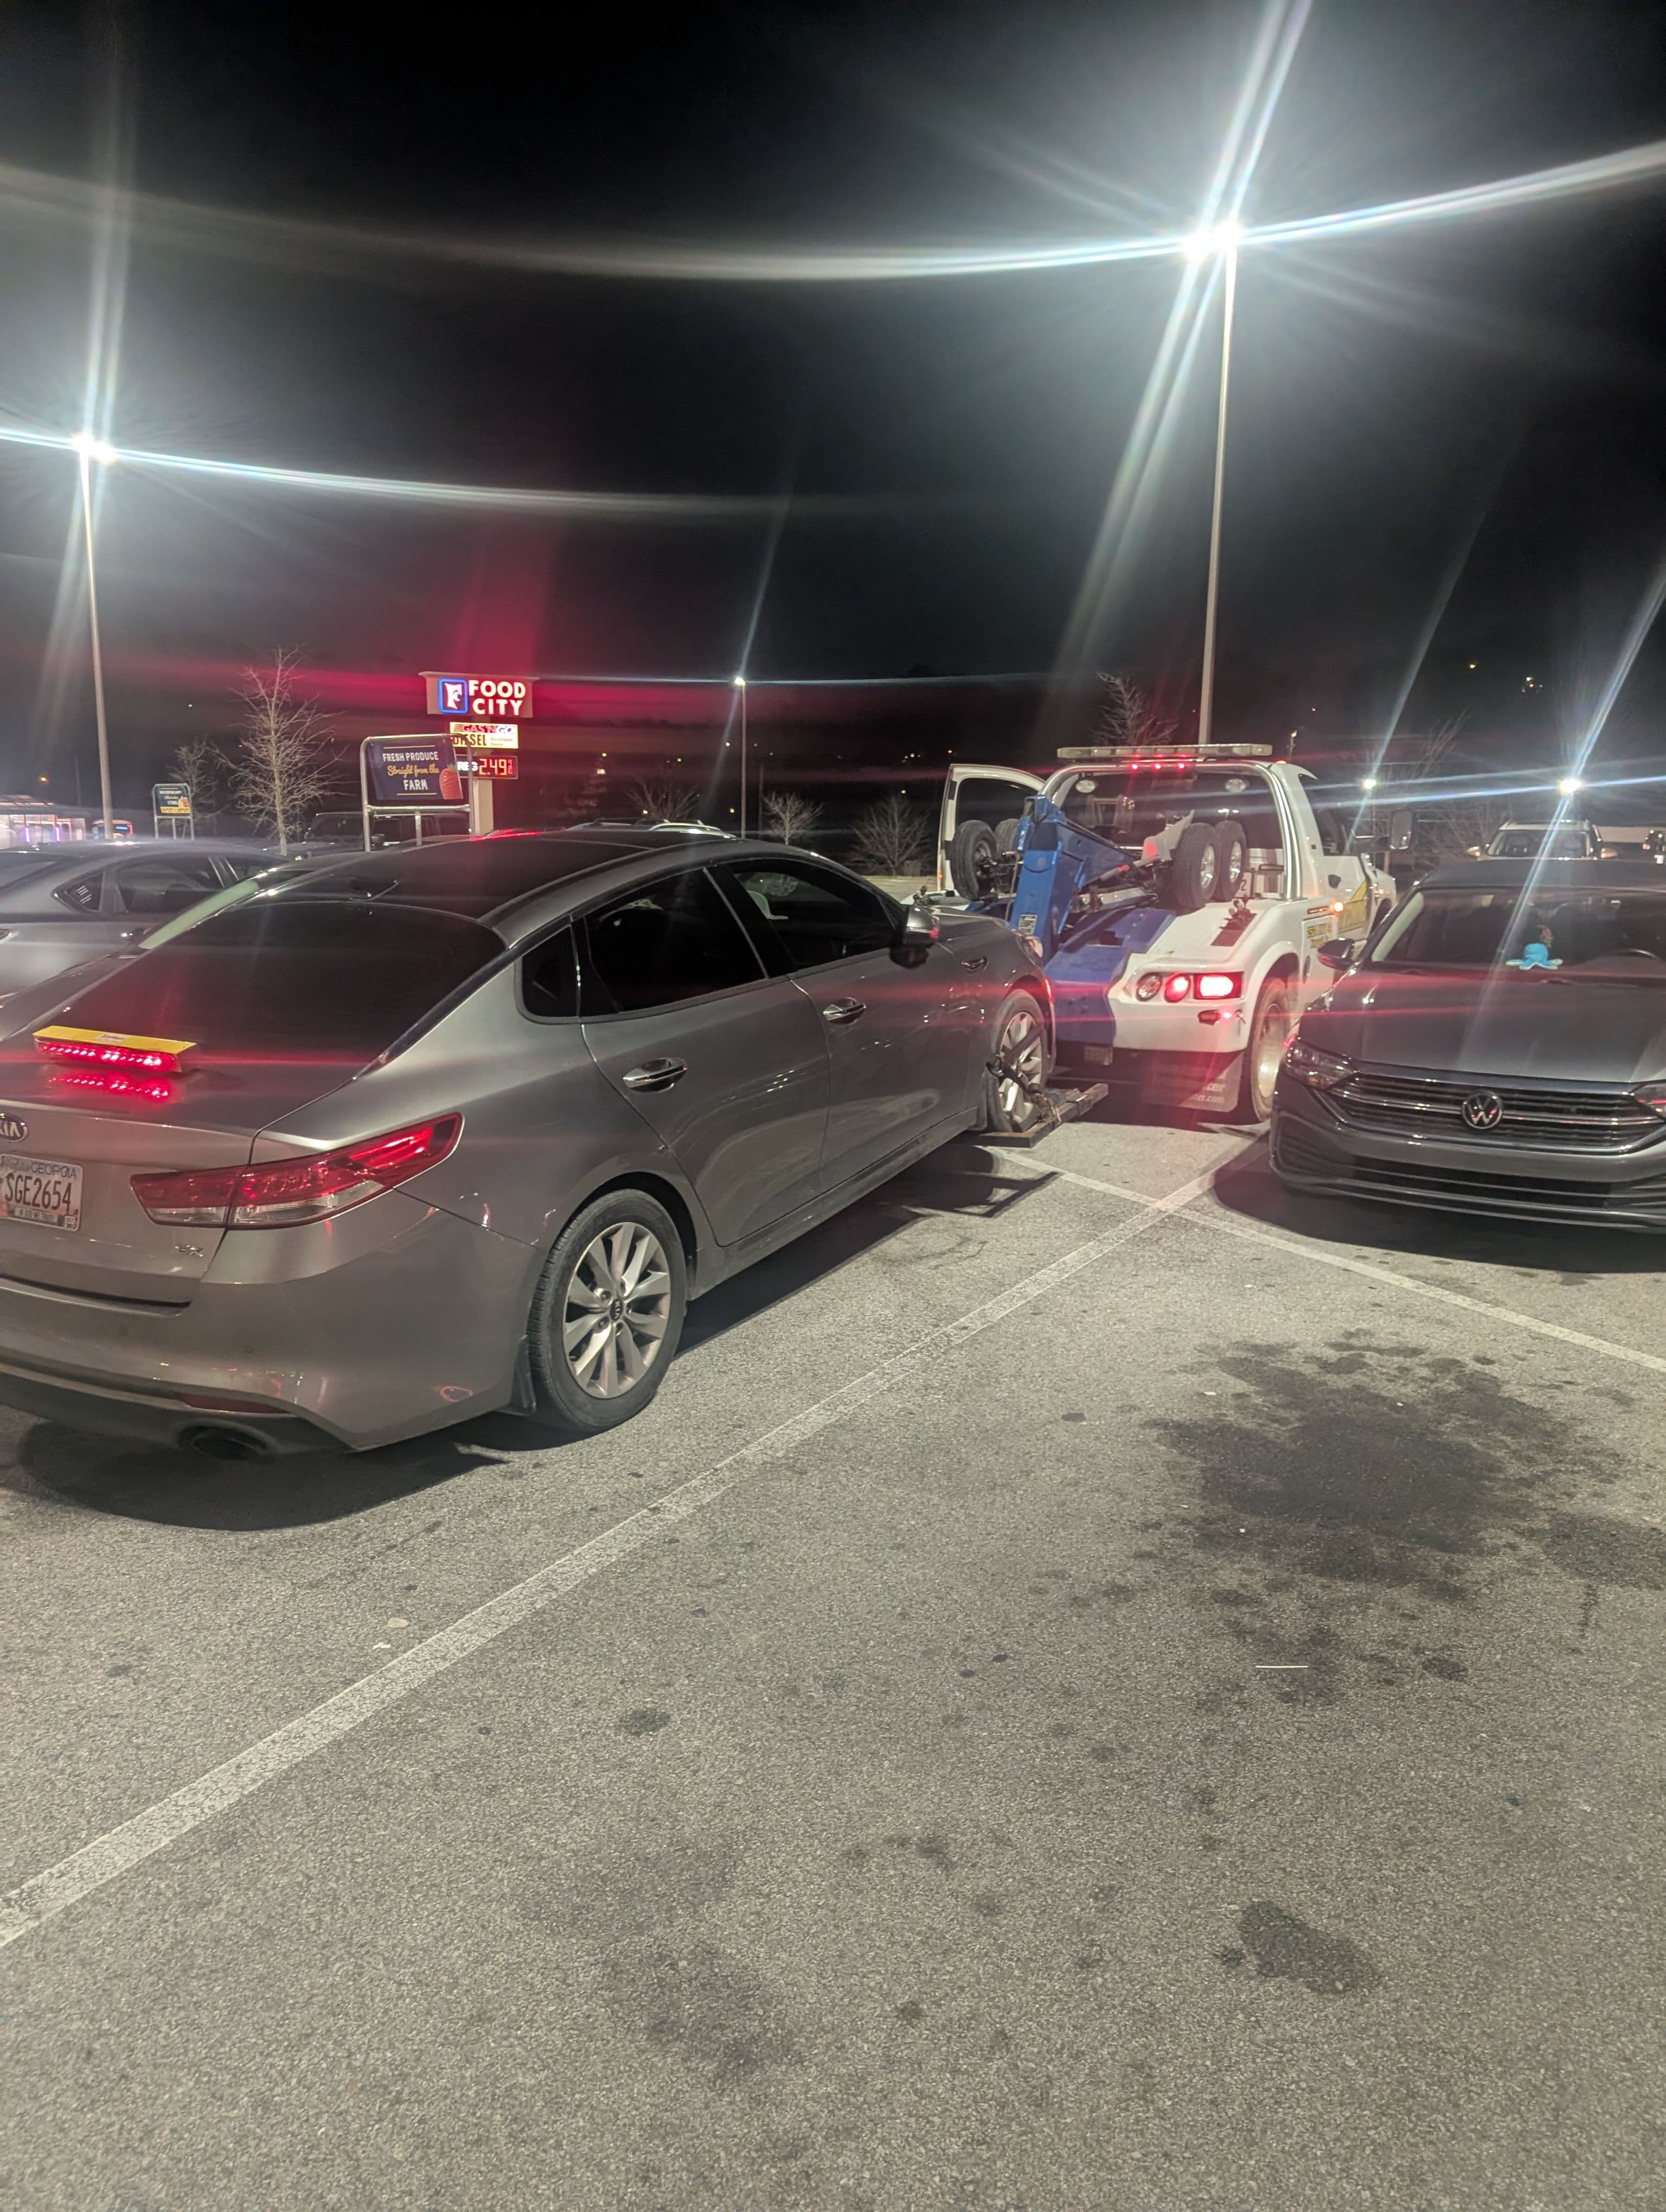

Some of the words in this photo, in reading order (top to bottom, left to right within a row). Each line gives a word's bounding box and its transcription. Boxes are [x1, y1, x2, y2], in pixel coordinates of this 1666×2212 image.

[468, 679, 526, 698] FOOD
[472, 698, 523, 716] CITY
[382, 753, 405, 762] FRESH
[405, 751, 439, 761] PRODUCE
[387, 764, 413, 779] Straight
[414, 765, 429, 777] from
[428, 763, 440, 773] the
[403, 779, 428, 790] FARM
[31, 1161, 76, 1180] GEORGIA
[5, 1172, 72, 1212] SGE2654
